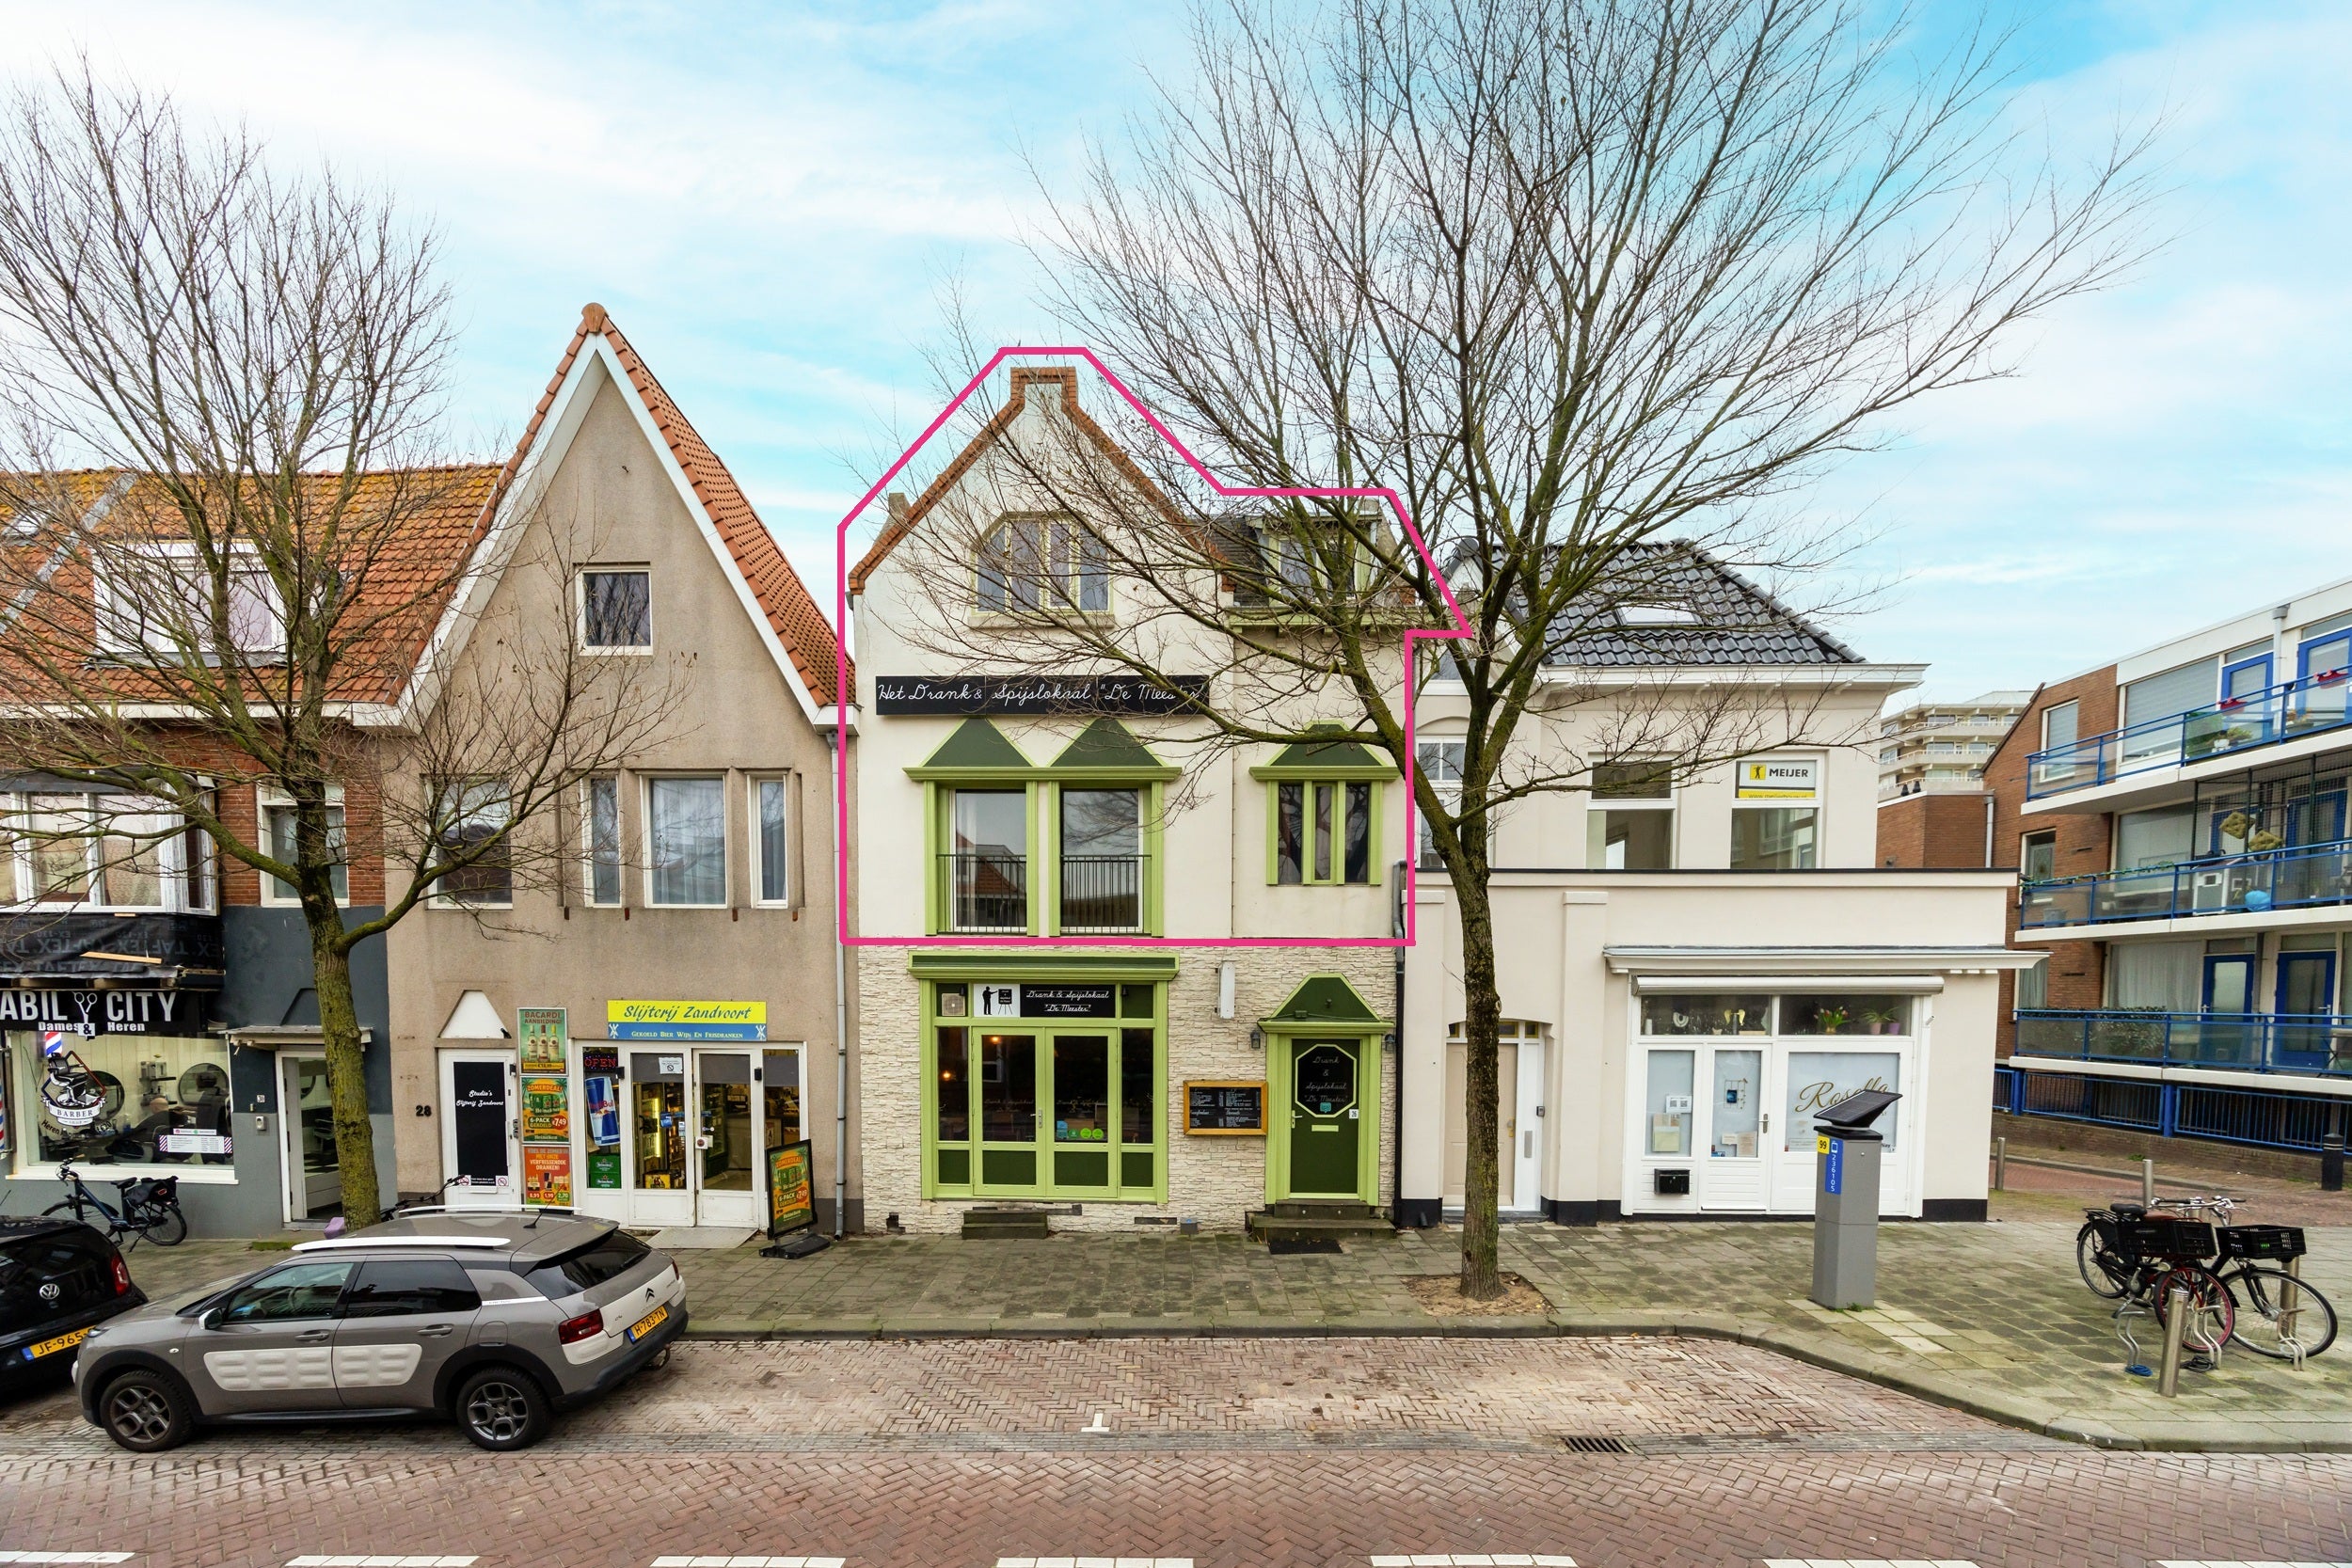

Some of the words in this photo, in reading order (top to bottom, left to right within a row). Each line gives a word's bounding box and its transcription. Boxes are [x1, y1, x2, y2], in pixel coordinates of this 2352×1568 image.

[878, 684, 906, 700] Het
[908, 683, 971, 700] Drank
[974, 689, 982, 699] &
[993, 684, 1091, 705] Spijslokaal
[1769, 768, 1808, 778] MEIJER
[1066, 990, 1109, 1001] Spijslokaal
[0, 990, 68, 1021] ABIL
[106, 990, 177, 1022] CITY
[624, 1006, 680, 1022] Slijterij
[683, 1006, 752, 1020] Zandvoort
[39, 1022, 79, 1032] Dames
[83, 1023, 92, 1035] &
[107, 1022, 145, 1032] Heren
[584, 1058, 616, 1068] OPEN
[57, 1109, 93, 1117] BARBER
[416, 1105, 432, 1117] 28
[1819, 1140, 1827, 1149] 99
[779, 1191, 795, 1202] 6-PACK
[634, 1308, 665, 1336] H-783-TN
